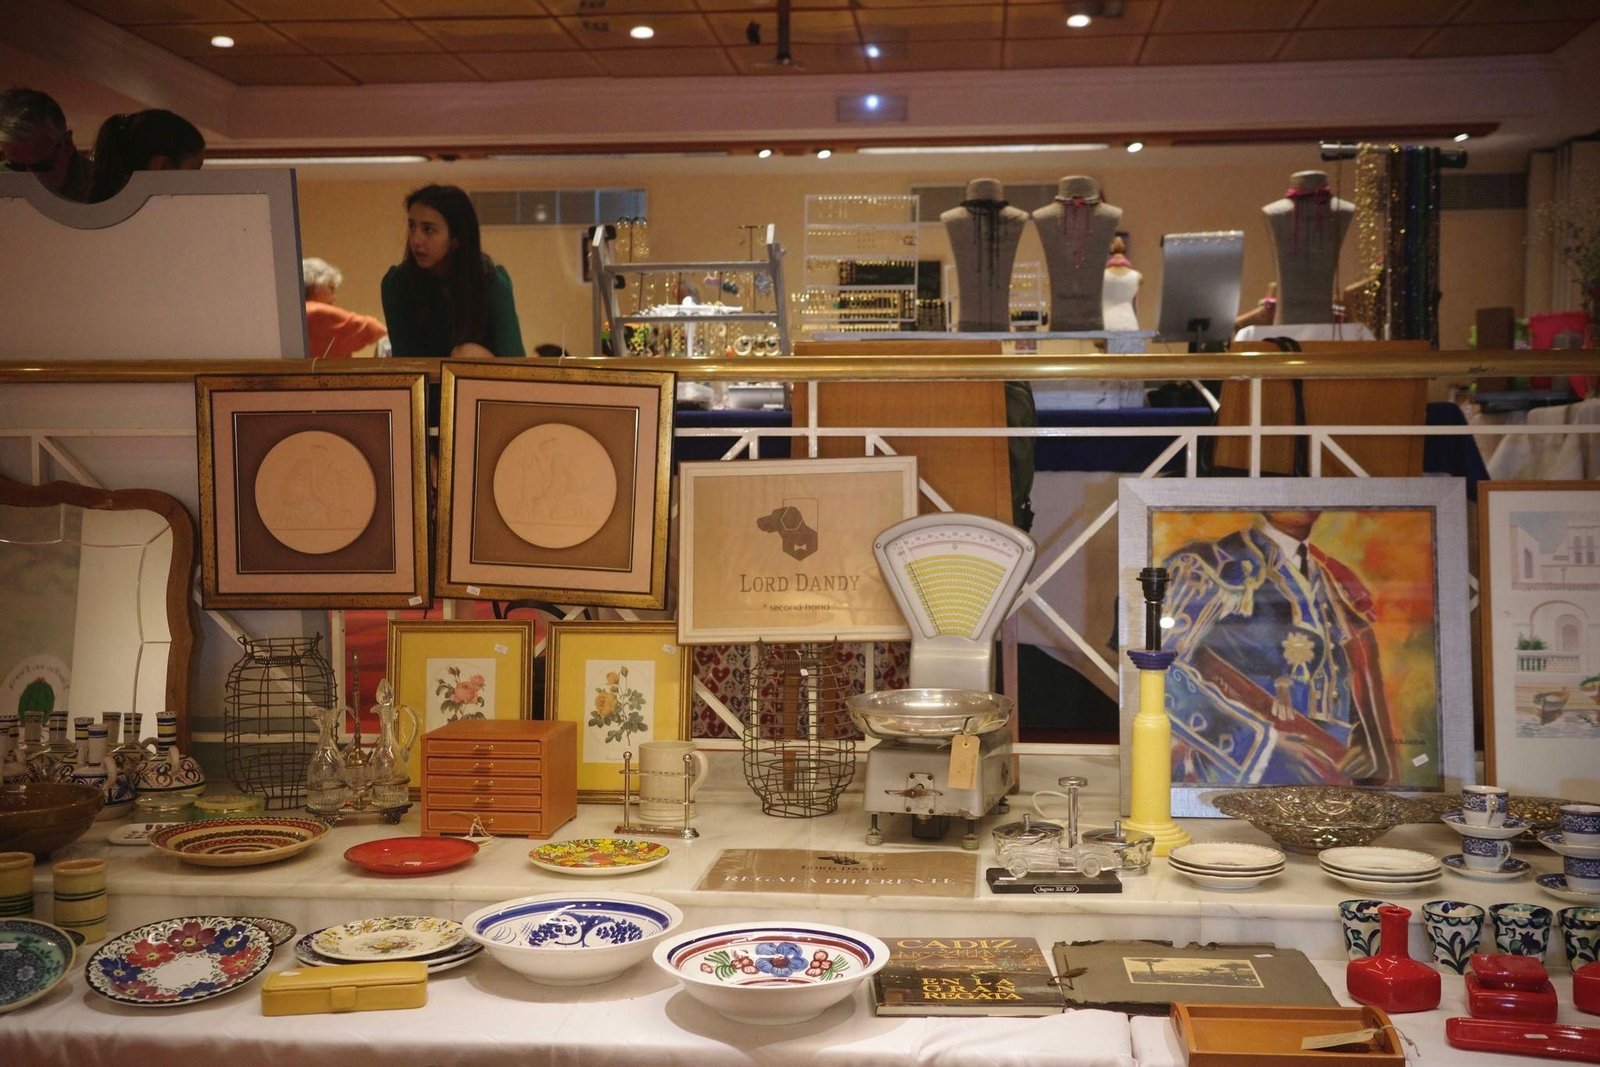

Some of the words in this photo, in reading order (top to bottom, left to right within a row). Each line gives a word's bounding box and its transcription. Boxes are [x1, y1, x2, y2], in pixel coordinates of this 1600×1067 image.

[739, 573, 789, 593] LORD
[795, 573, 861, 592] DANDY
[921, 977, 961, 985] EN
[921, 985, 1017, 993] GRAN
[922, 992, 1025, 1000] REGATA
